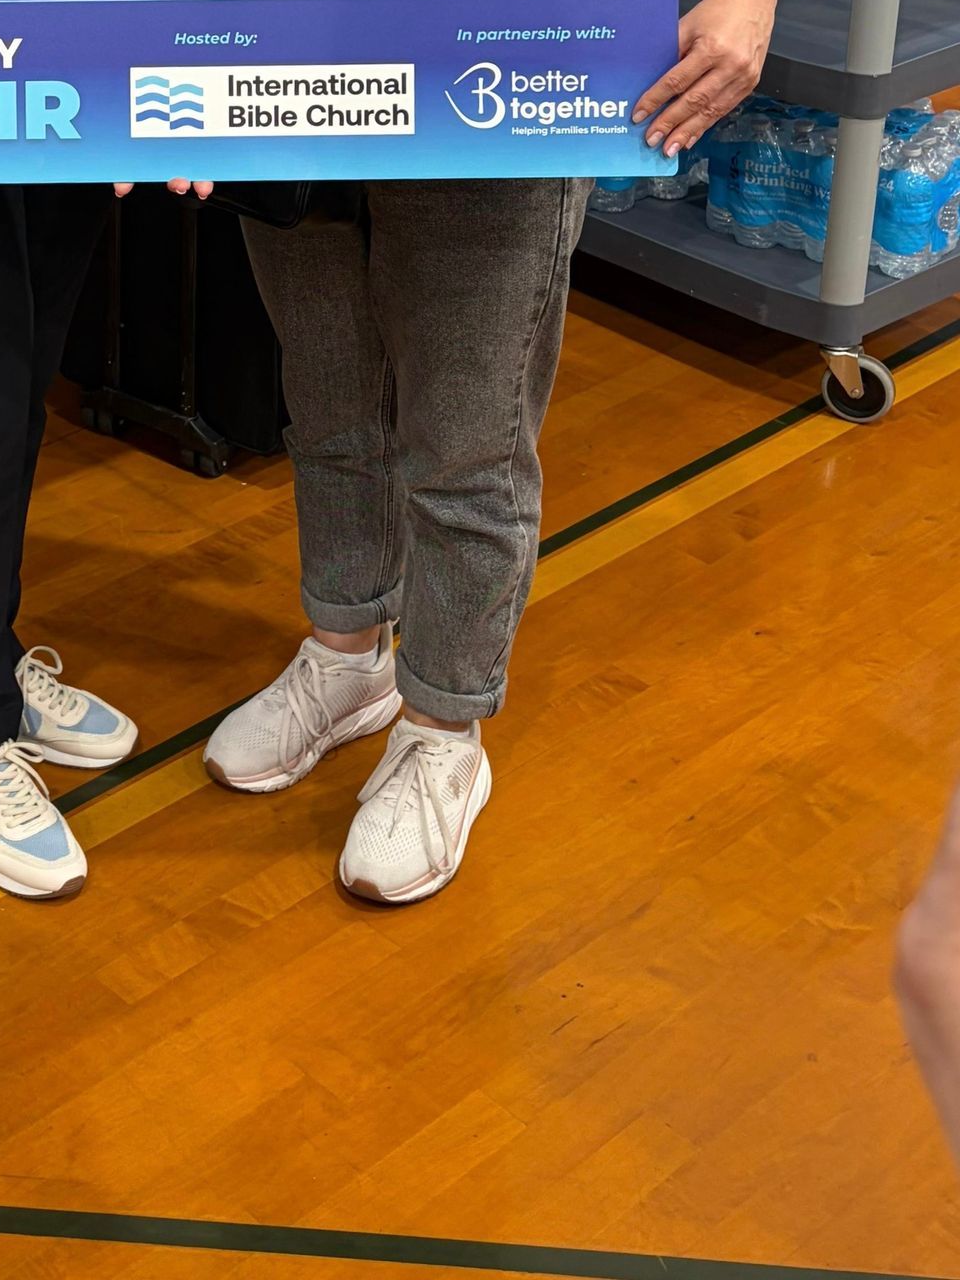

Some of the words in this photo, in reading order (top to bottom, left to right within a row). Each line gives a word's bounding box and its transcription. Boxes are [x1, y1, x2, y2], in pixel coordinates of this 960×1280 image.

[174, 32, 230, 45] Hosted
[234, 32, 258, 47] by:
[456, 29, 472, 41] In
[476, 26, 572, 43] partnership
[575, 26, 616, 40] with:
[228, 73, 407, 97] International
[511, 70, 588, 92] better
[228, 105, 298, 128] Bible
[306, 103, 410, 126] Church
[510, 96, 628, 125] together
[511, 126, 548, 136] Helping
[550, 125, 589, 135] Families
[590, 125, 628, 134] Flourish
[744, 159, 810, 179] Purified
[744, 172, 813, 196] Drinking
[879, 179, 894, 193] 24
